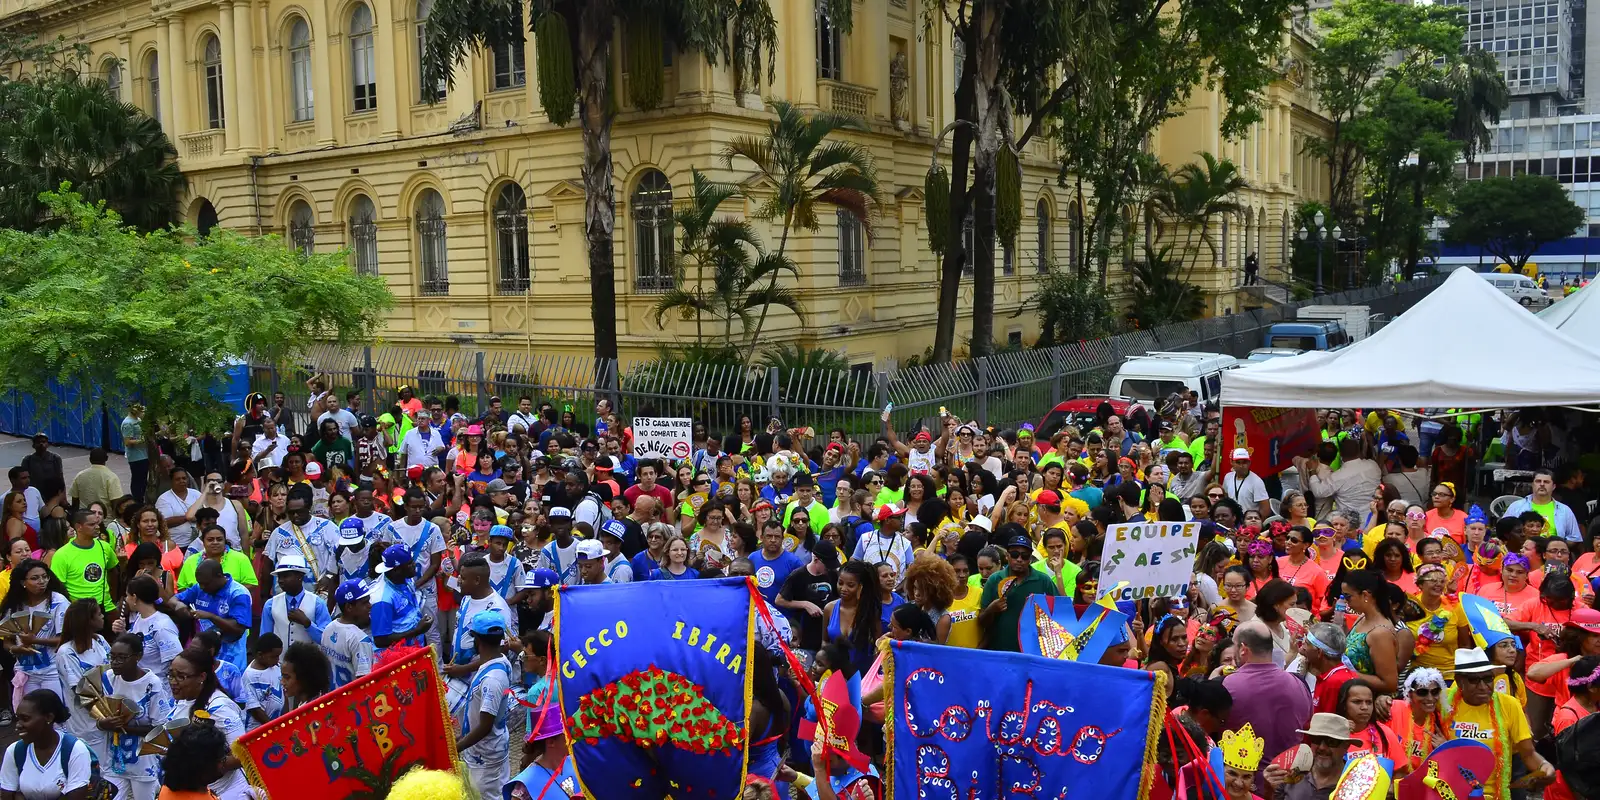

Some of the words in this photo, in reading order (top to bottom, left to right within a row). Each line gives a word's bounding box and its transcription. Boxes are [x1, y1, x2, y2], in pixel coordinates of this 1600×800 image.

[635, 418, 650, 426] STS
[635, 440, 672, 456] DENGUE
[1115, 523, 1195, 541] EQUIPE
[1134, 551, 1163, 567] AE
[1100, 583, 1188, 601] UCURUVI
[955, 611, 973, 622] Zika
[562, 620, 629, 679] CECCO
[671, 621, 742, 675] IBIRA
[904, 667, 1123, 764] Cordão
[1461, 726, 1488, 739] Zika
